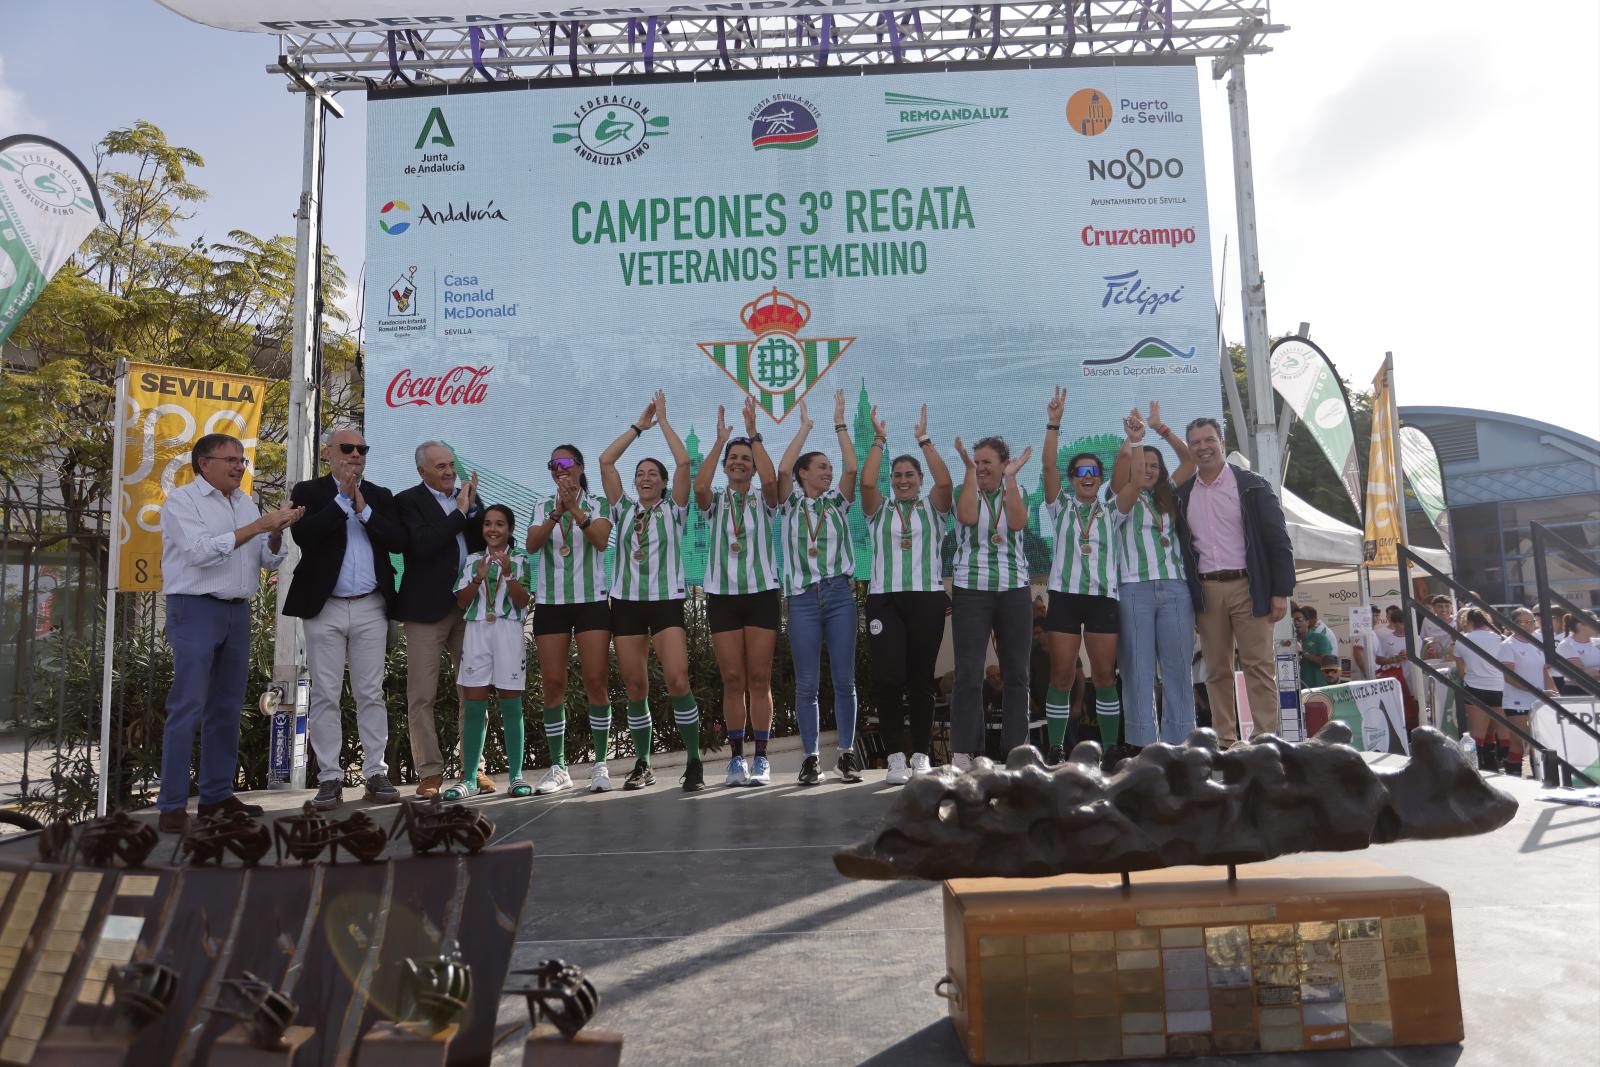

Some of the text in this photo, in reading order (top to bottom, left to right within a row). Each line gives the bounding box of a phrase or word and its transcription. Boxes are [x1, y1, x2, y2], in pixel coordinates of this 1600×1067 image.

[259, 7, 645, 31] FEDERACIÓN
[574, 95, 649, 118] FEDERACION
[747, 98, 770, 121] REGATA
[900, 107, 1009, 122] REMOANDALUZ
[1120, 98, 1168, 110] Puerto
[1121, 111, 1183, 124] de Sevilla
[421, 152, 448, 162] Junta
[574, 142, 650, 165] ANDALUZA REMO
[404, 161, 465, 174] de Andalucía
[13, 178, 50, 212] ANDALUZA
[418, 200, 509, 226] Andalucía
[571, 193, 787, 245] CAMPEONES
[846, 185, 975, 234] REGATA
[1081, 224, 1196, 248] Cruzcampo
[619, 240, 927, 286] VETERANOS FEMENINO
[444, 275, 478, 287] Casa
[1102, 269, 1185, 315] Filippi
[444, 289, 494, 304] Ronald
[444, 304, 517, 320] McDonald
[444, 328, 472, 336] SEVILLA
[1168, 363, 1199, 375] Sevilla
[140, 372, 255, 404] SEVILLA
[385, 365, 495, 408] Coca-Cola
